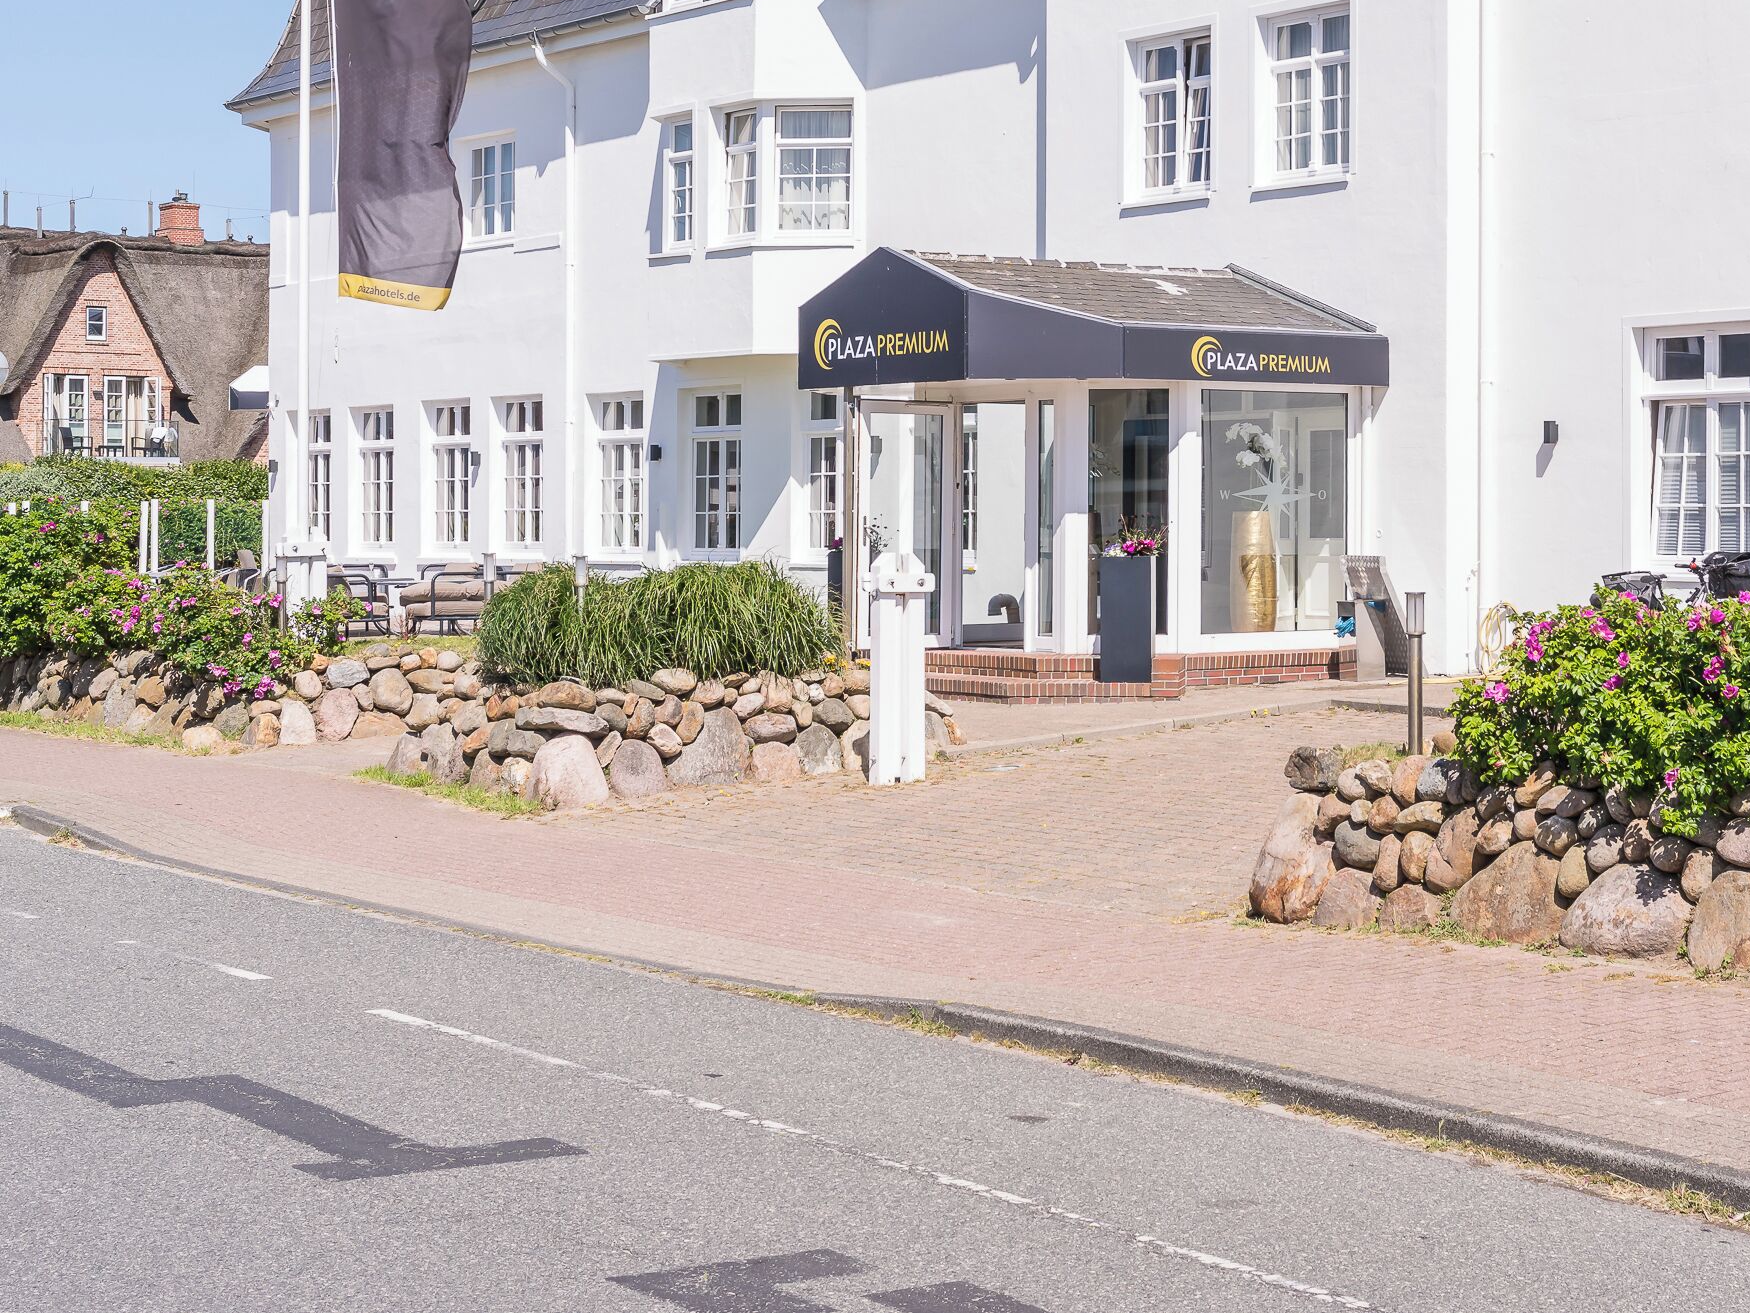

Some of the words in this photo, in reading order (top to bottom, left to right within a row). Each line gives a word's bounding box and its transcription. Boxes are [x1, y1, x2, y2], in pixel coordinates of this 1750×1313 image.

[828, 335, 876, 361] PLAZA
[877, 329, 949, 357] PREMIUM
[1207, 351, 1258, 371] PLAZA
[1259, 354, 1331, 373] PREMIUM
